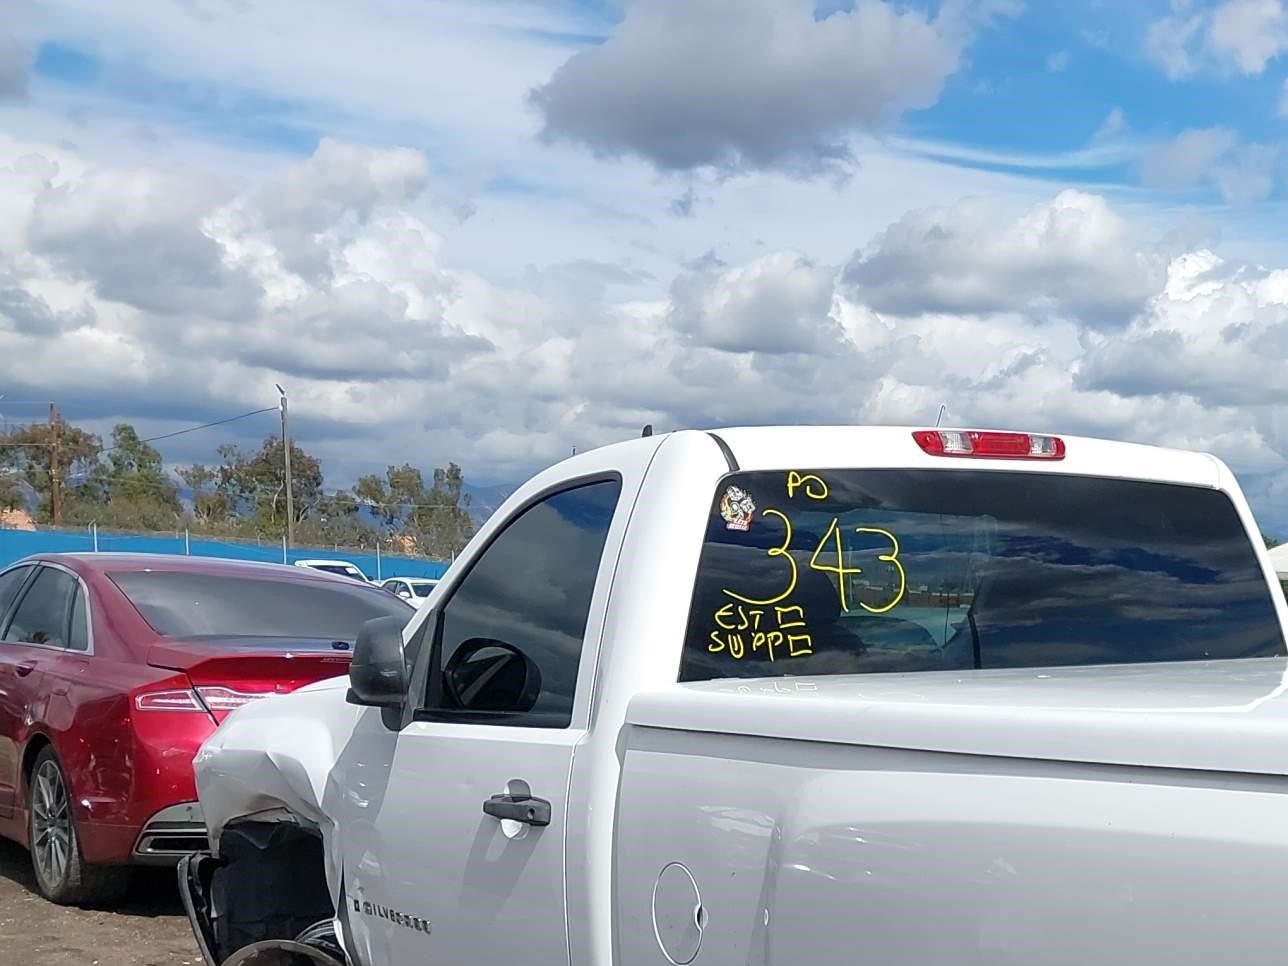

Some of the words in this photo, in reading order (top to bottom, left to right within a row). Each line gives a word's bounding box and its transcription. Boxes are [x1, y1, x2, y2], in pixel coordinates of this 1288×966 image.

[723, 509, 905, 613] 343
[715, 604, 764, 629] EST
[709, 632, 782, 661] SUPP
